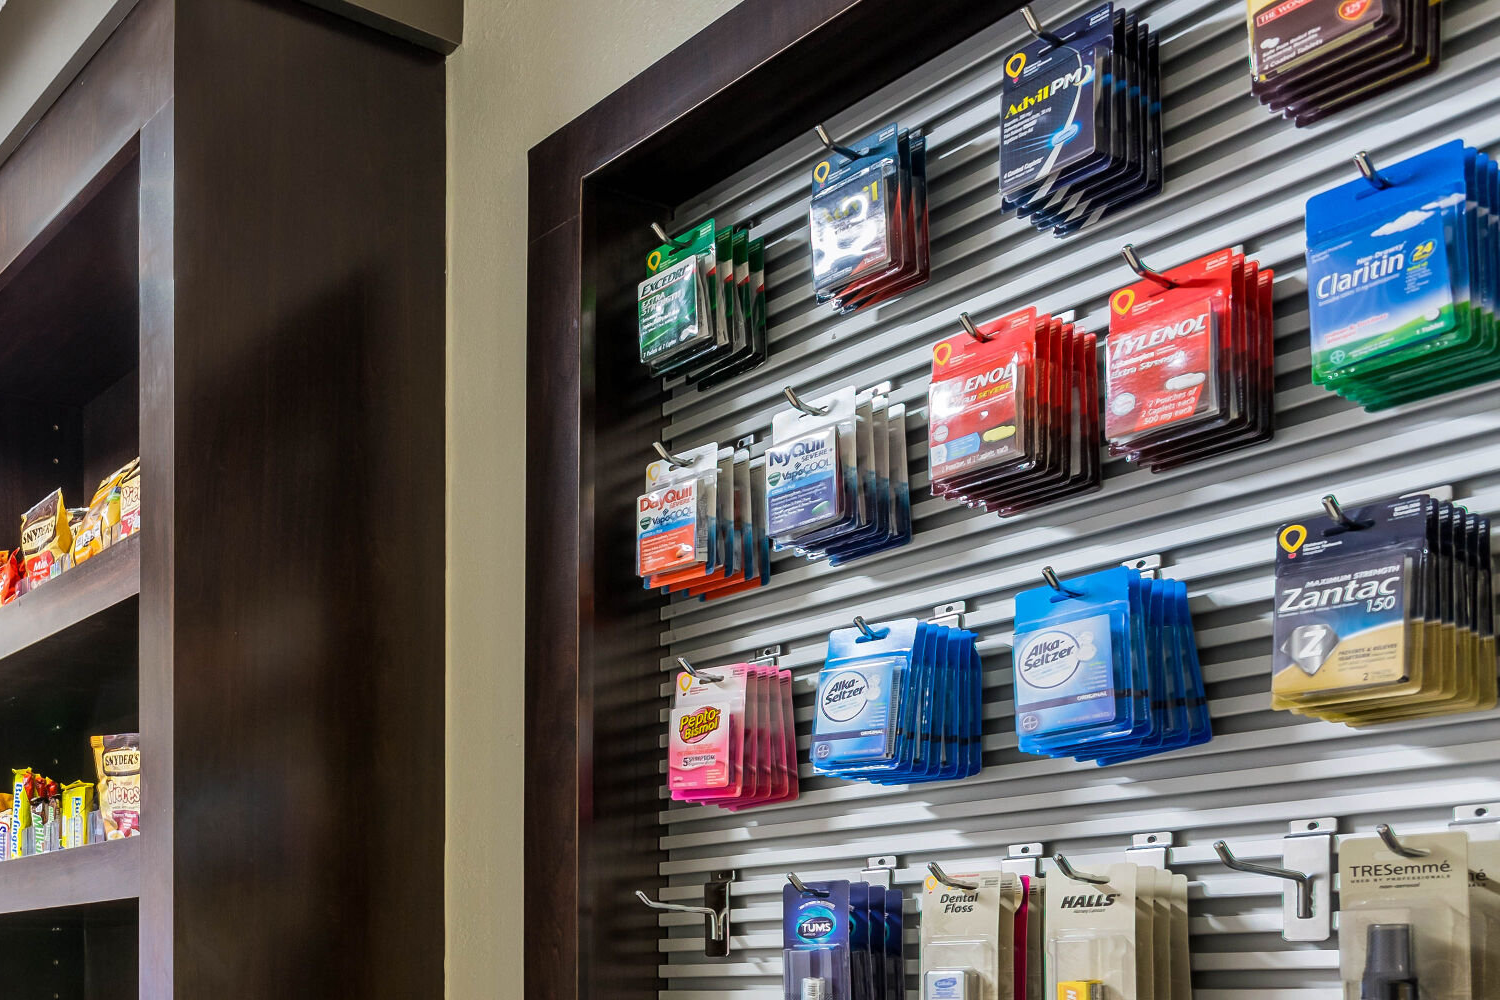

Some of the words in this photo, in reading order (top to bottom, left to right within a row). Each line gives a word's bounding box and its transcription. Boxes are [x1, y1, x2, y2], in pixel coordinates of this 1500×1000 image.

[1005, 85, 1049, 119] Advil
[1050, 67, 1083, 96] PM
[1413, 241, 1433, 257] 24
[641, 263, 694, 298] EXCEDRI
[1316, 253, 1404, 300] Claritin
[1111, 313, 1209, 361] TYLENOL
[802, 448, 828, 462] SEVERE
[1305, 574, 1352, 588] MAXIMUM
[1353, 565, 1400, 579] STRENGTH
[1277, 577, 1400, 615] Zantac
[1367, 596, 1395, 613] 150
[1023, 645, 1074, 672] Seltzer
[1027, 638, 1065, 660] Alka-
[829, 678, 859, 693] Alka-
[825, 687, 865, 706] Seltzer
[679, 708, 721, 731] Pepto-
[683, 719, 719, 740] Bismol
[105, 752, 139, 767] SNYDER'S
[12, 782, 23, 860] Butterfinger
[1350, 860, 1451, 877] TRESemmé
[940, 893, 979, 905] Dental
[944, 903, 973, 914] Floss
[1061, 894, 1117, 909] HALLS
[801, 923, 832, 933] TUMS
